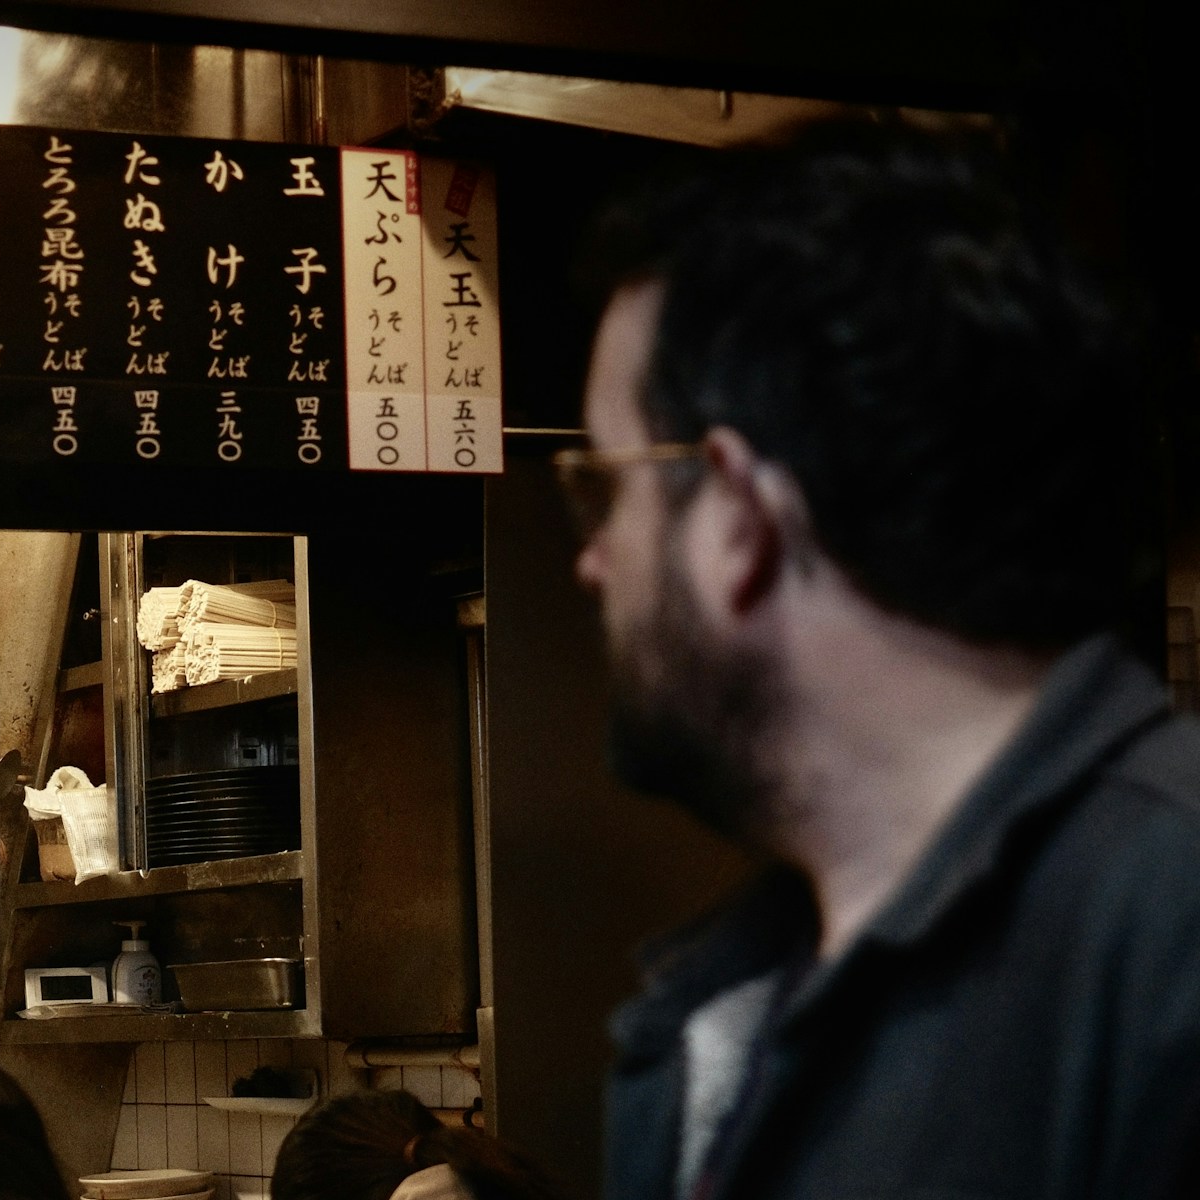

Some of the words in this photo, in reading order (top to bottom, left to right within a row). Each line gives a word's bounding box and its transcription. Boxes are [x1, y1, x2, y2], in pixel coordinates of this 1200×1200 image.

[39, 136, 84, 292] とろろ昆布
[124, 141, 166, 287] たぬき
[204, 150, 245, 288] かけ
[283, 156, 327, 294] 玉子
[364, 160, 404, 296] 天ぷら
[443, 222, 482, 308] 天玉
[52, 386, 78, 456] 四五〇
[134, 390, 161, 459] 四五〇
[216, 391, 242, 462] 三九〇
[296, 396, 322, 464] 四五〇
[376, 397, 399, 466] 五〇〇
[453, 400, 476, 467] 五六〇
